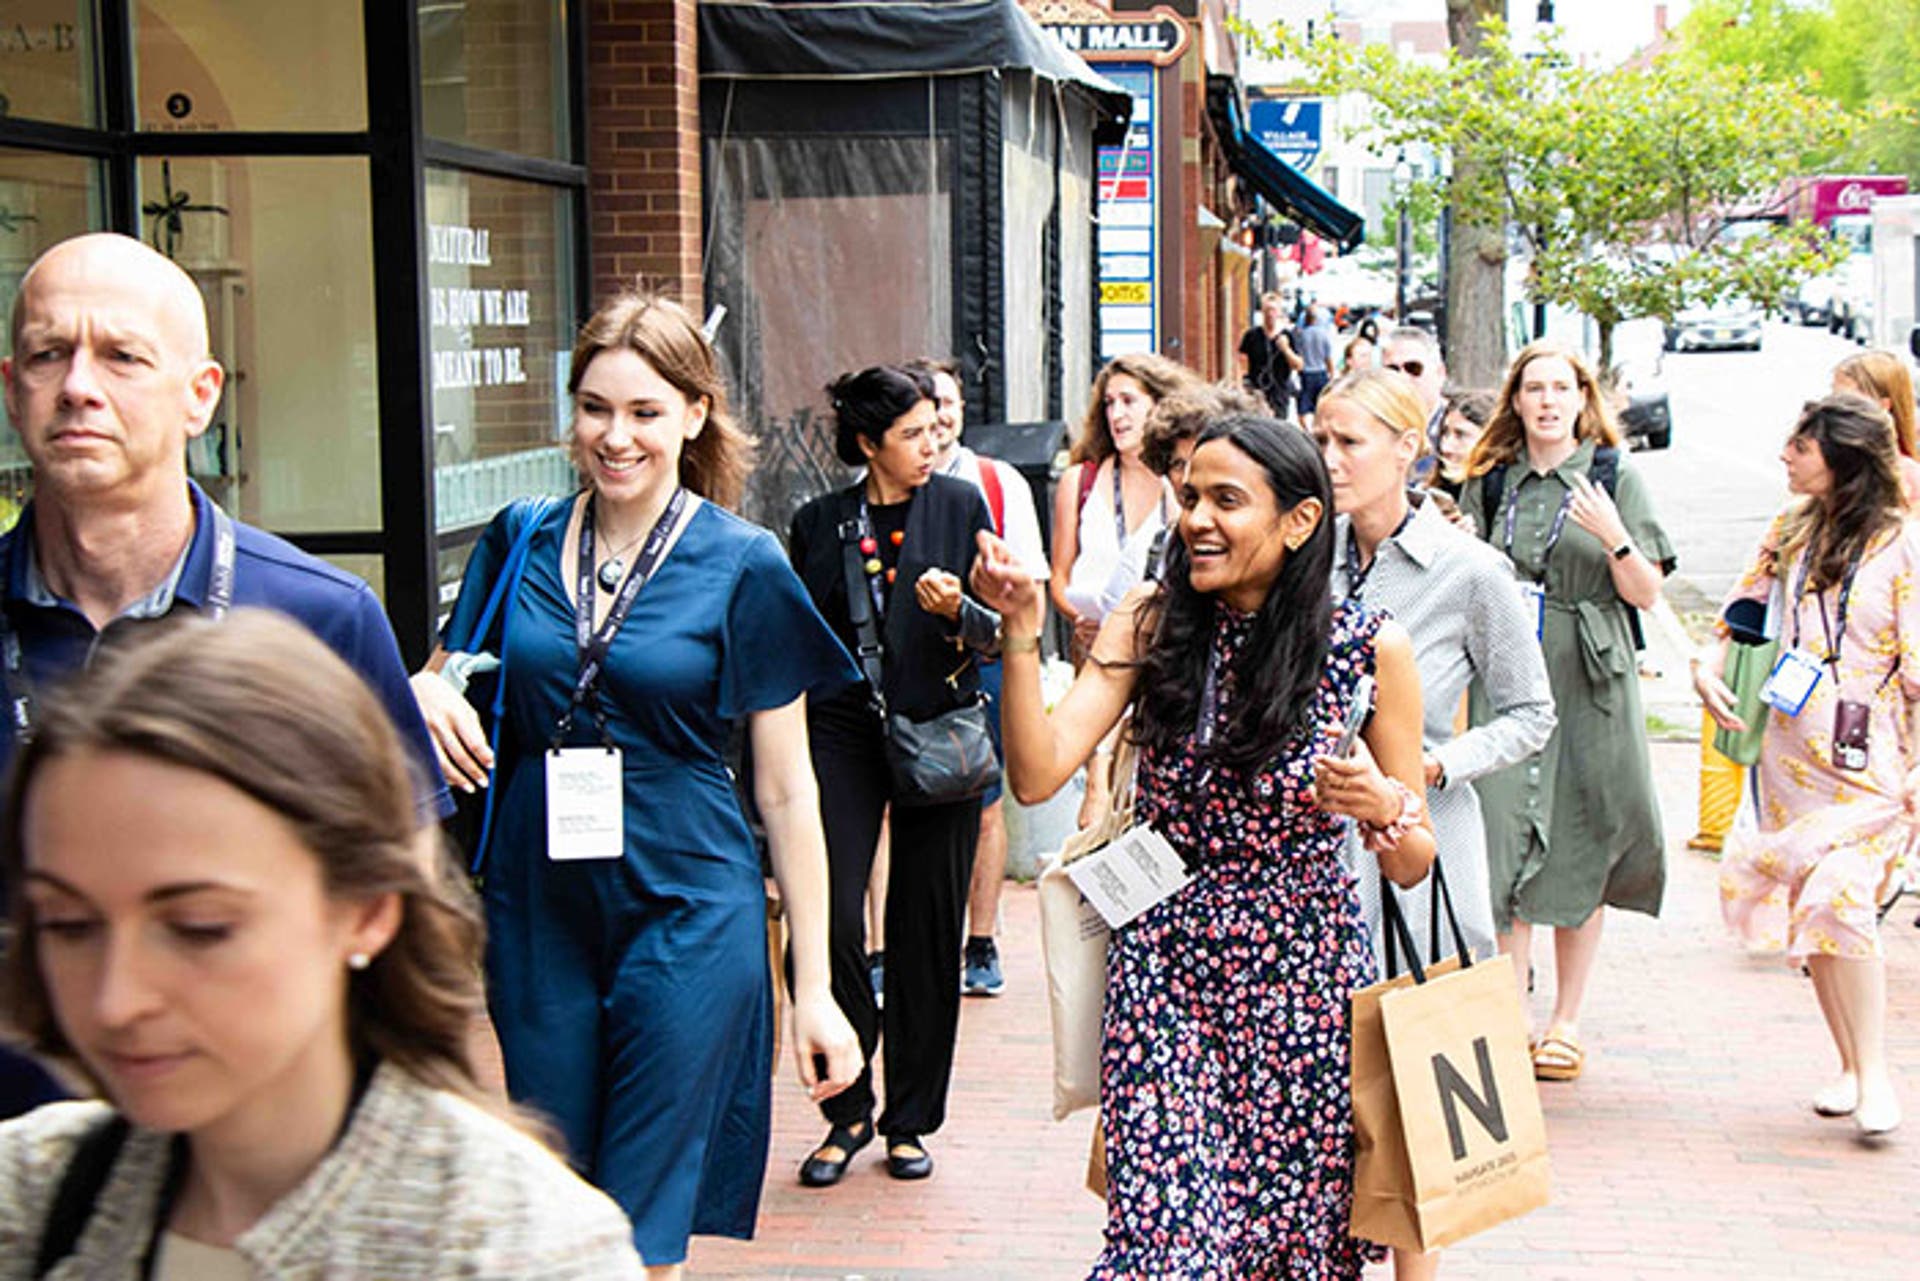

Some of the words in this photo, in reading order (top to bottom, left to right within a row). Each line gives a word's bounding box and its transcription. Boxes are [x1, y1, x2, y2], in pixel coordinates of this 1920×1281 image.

[1087, 25, 1168, 50] MALL
[430, 287, 447, 326] IS
[448, 289, 482, 326] HOW
[482, 290, 504, 326] WE
[505, 290, 531, 326] ARE
[432, 349, 482, 389] MEANT
[484, 348, 504, 386] TO
[1431, 1036, 1509, 1162] N
